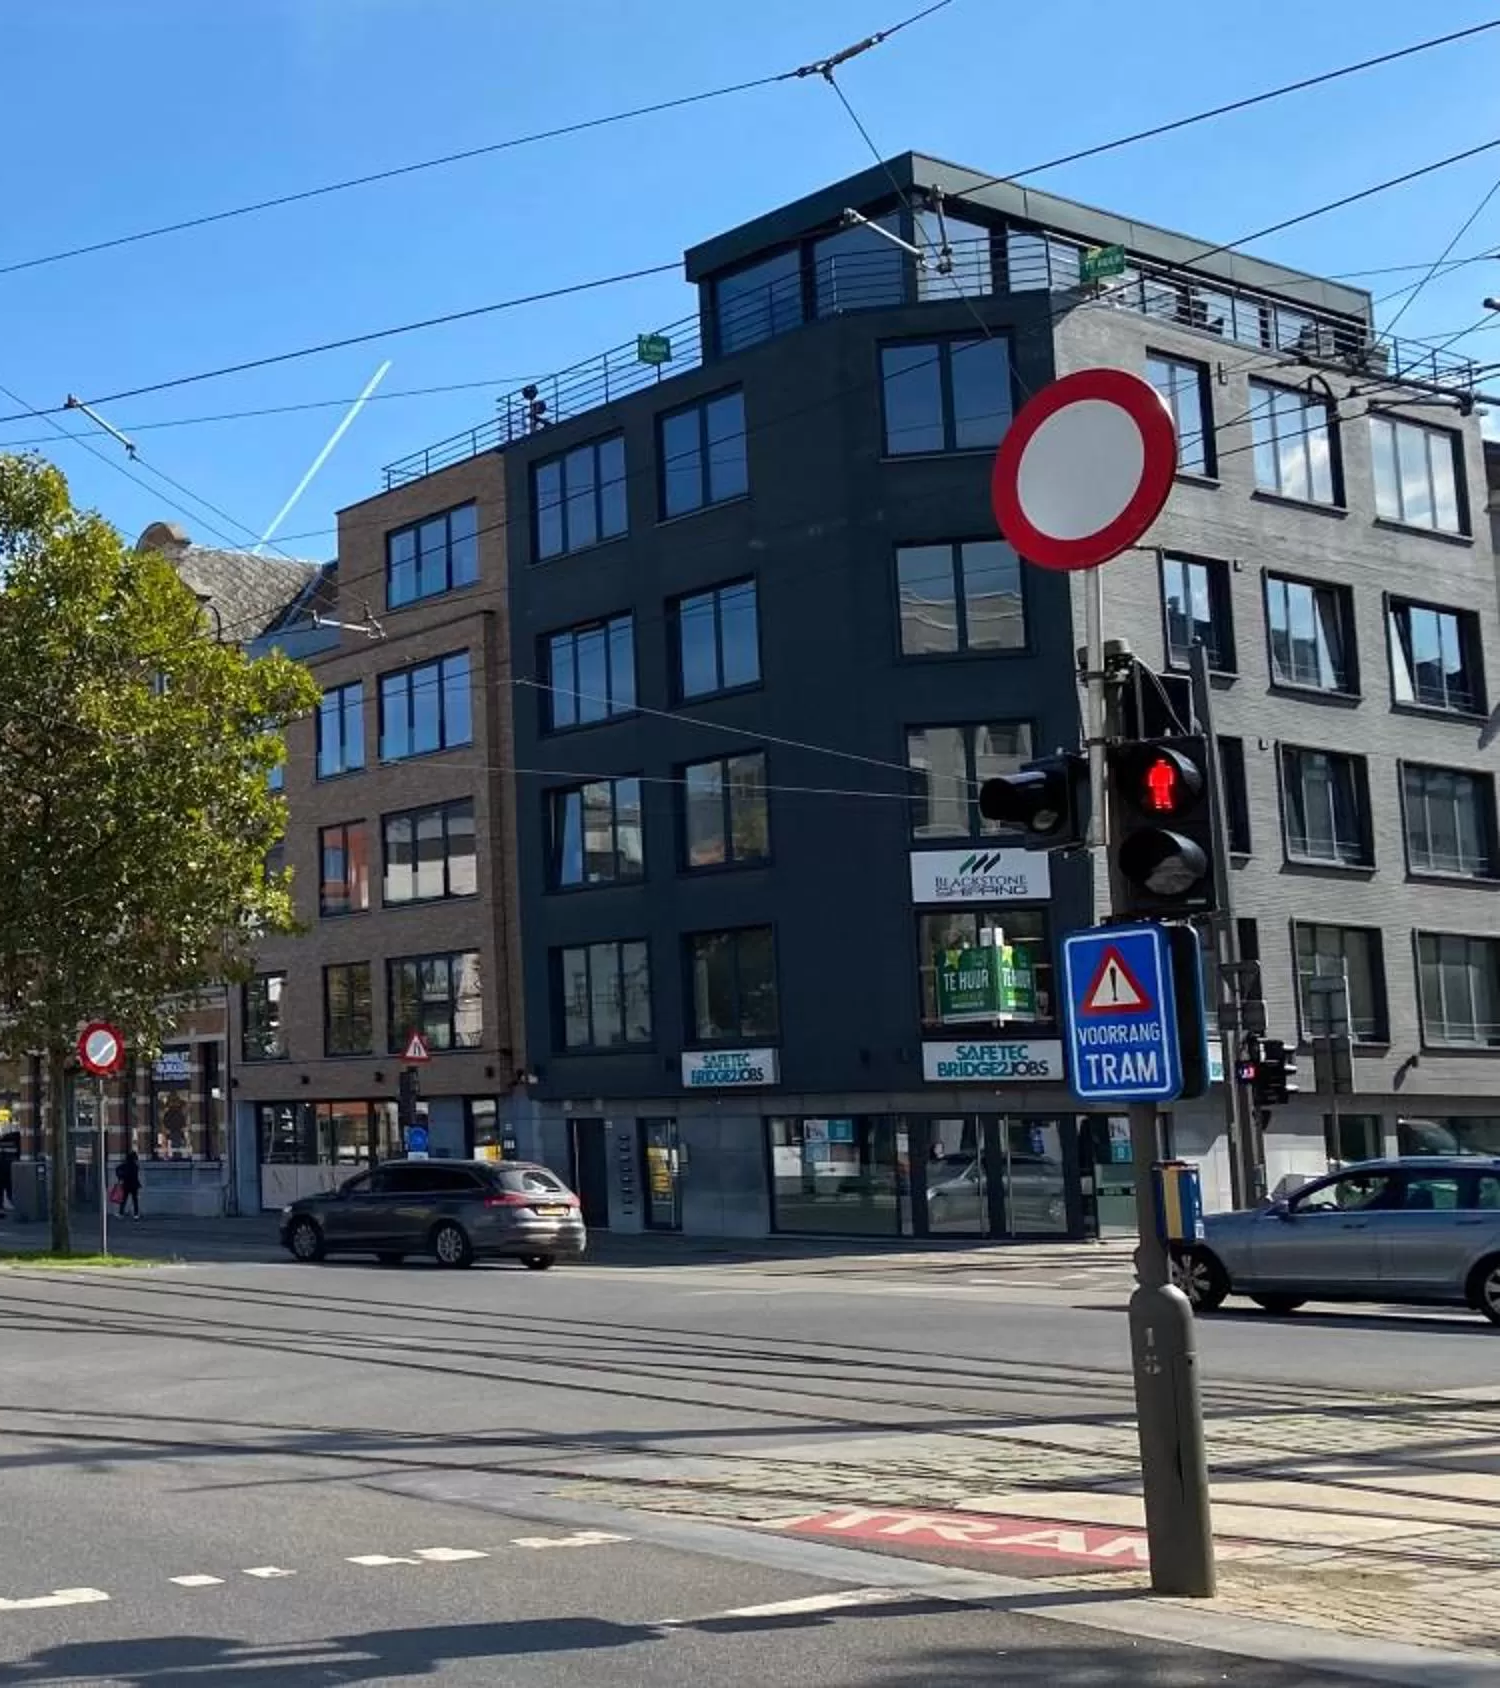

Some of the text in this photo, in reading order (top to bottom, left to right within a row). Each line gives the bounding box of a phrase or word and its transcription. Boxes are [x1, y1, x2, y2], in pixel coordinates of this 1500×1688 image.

[935, 874, 1028, 888] BLACKSTONE
[1078, 1022, 1160, 1046] VOORRANG
[956, 1044, 1029, 1061] SAFETEC
[937, 1060, 1049, 1077] BRIDGE2JOBS
[1085, 1050, 1159, 1085] TRAM
